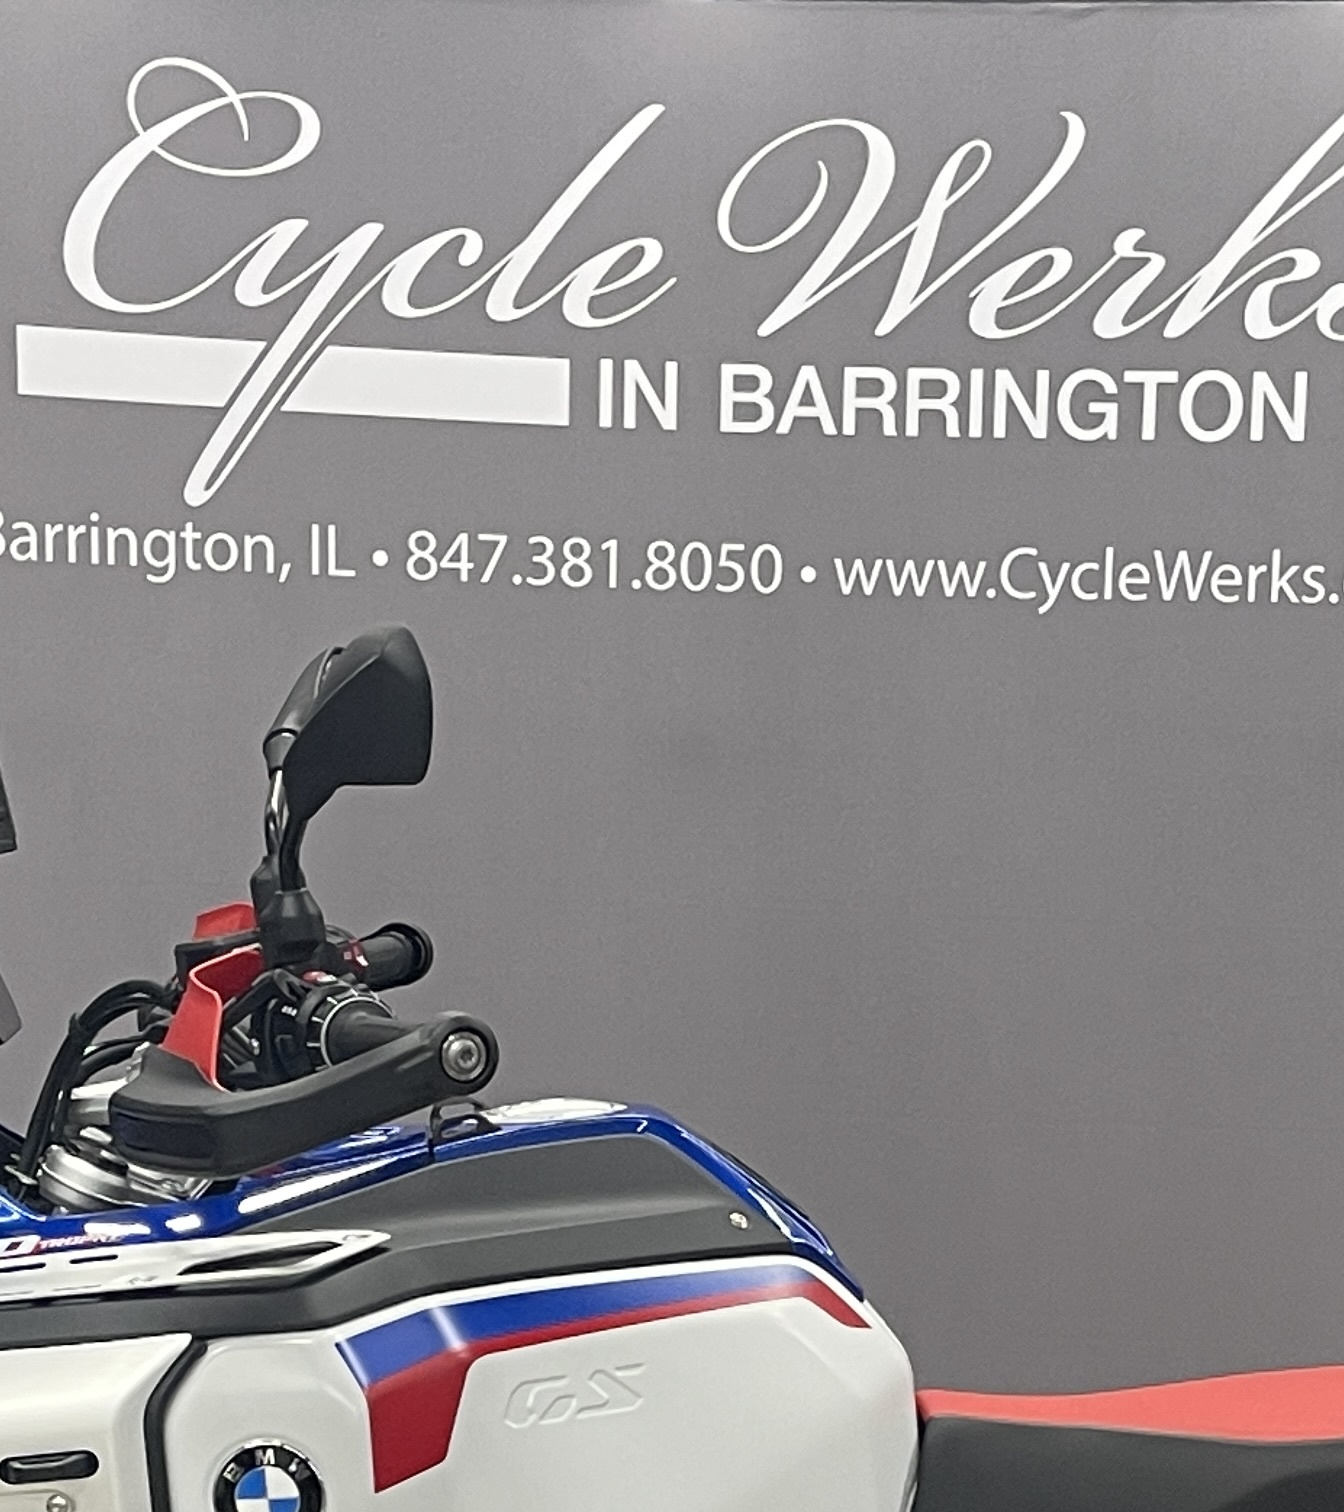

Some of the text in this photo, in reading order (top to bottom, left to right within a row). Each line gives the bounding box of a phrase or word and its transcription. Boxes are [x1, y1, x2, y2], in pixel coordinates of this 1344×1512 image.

[62, 57, 678, 508] Cycle
[598, 358, 1308, 443] IN BARRINGTON
[311, 523, 356, 577] IL
[406, 529, 783, 595] 847.381.8050
[504, 1362, 646, 1429] GS
[222, 1447, 313, 1483] BMW
